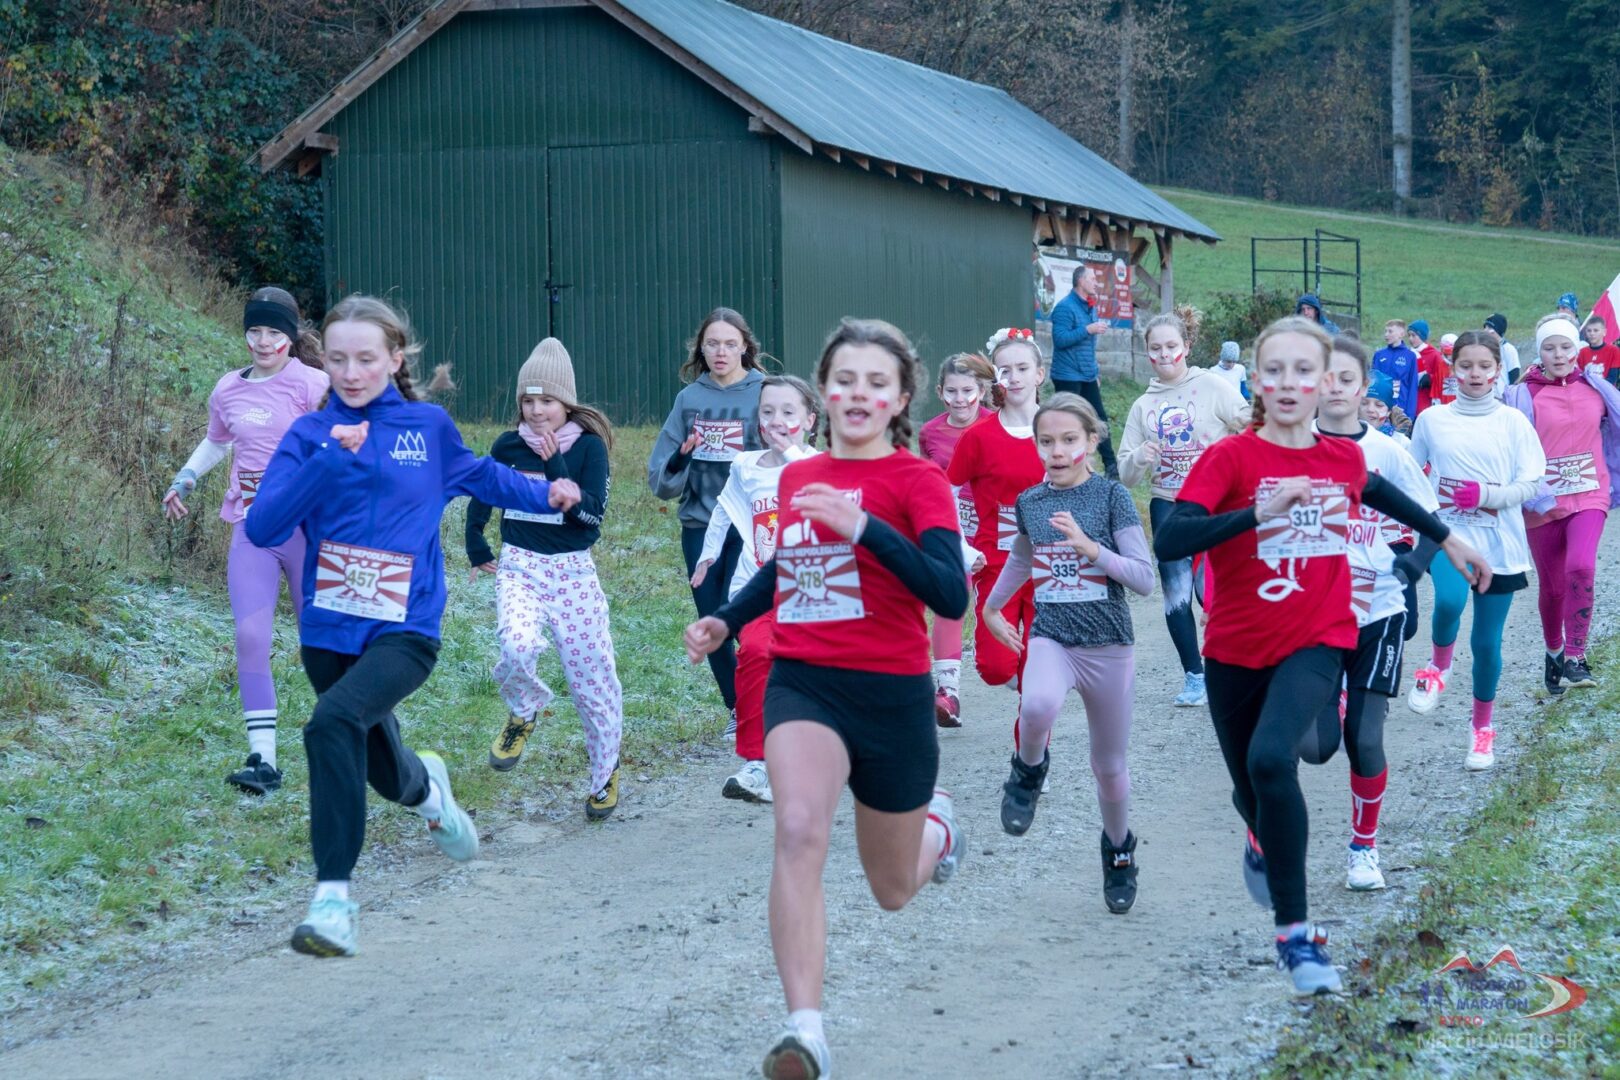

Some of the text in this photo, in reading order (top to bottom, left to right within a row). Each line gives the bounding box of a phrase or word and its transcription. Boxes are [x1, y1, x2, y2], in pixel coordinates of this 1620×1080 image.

[705, 434, 722, 444] 497
[389, 450, 428, 461] VERTICAL
[1174, 462, 1189, 473] 431
[1562, 468, 1579, 478] 469
[1292, 509, 1319, 526] 317
[1053, 564, 1077, 578] 335
[347, 569, 377, 588] 457
[799, 571, 822, 589] 478
